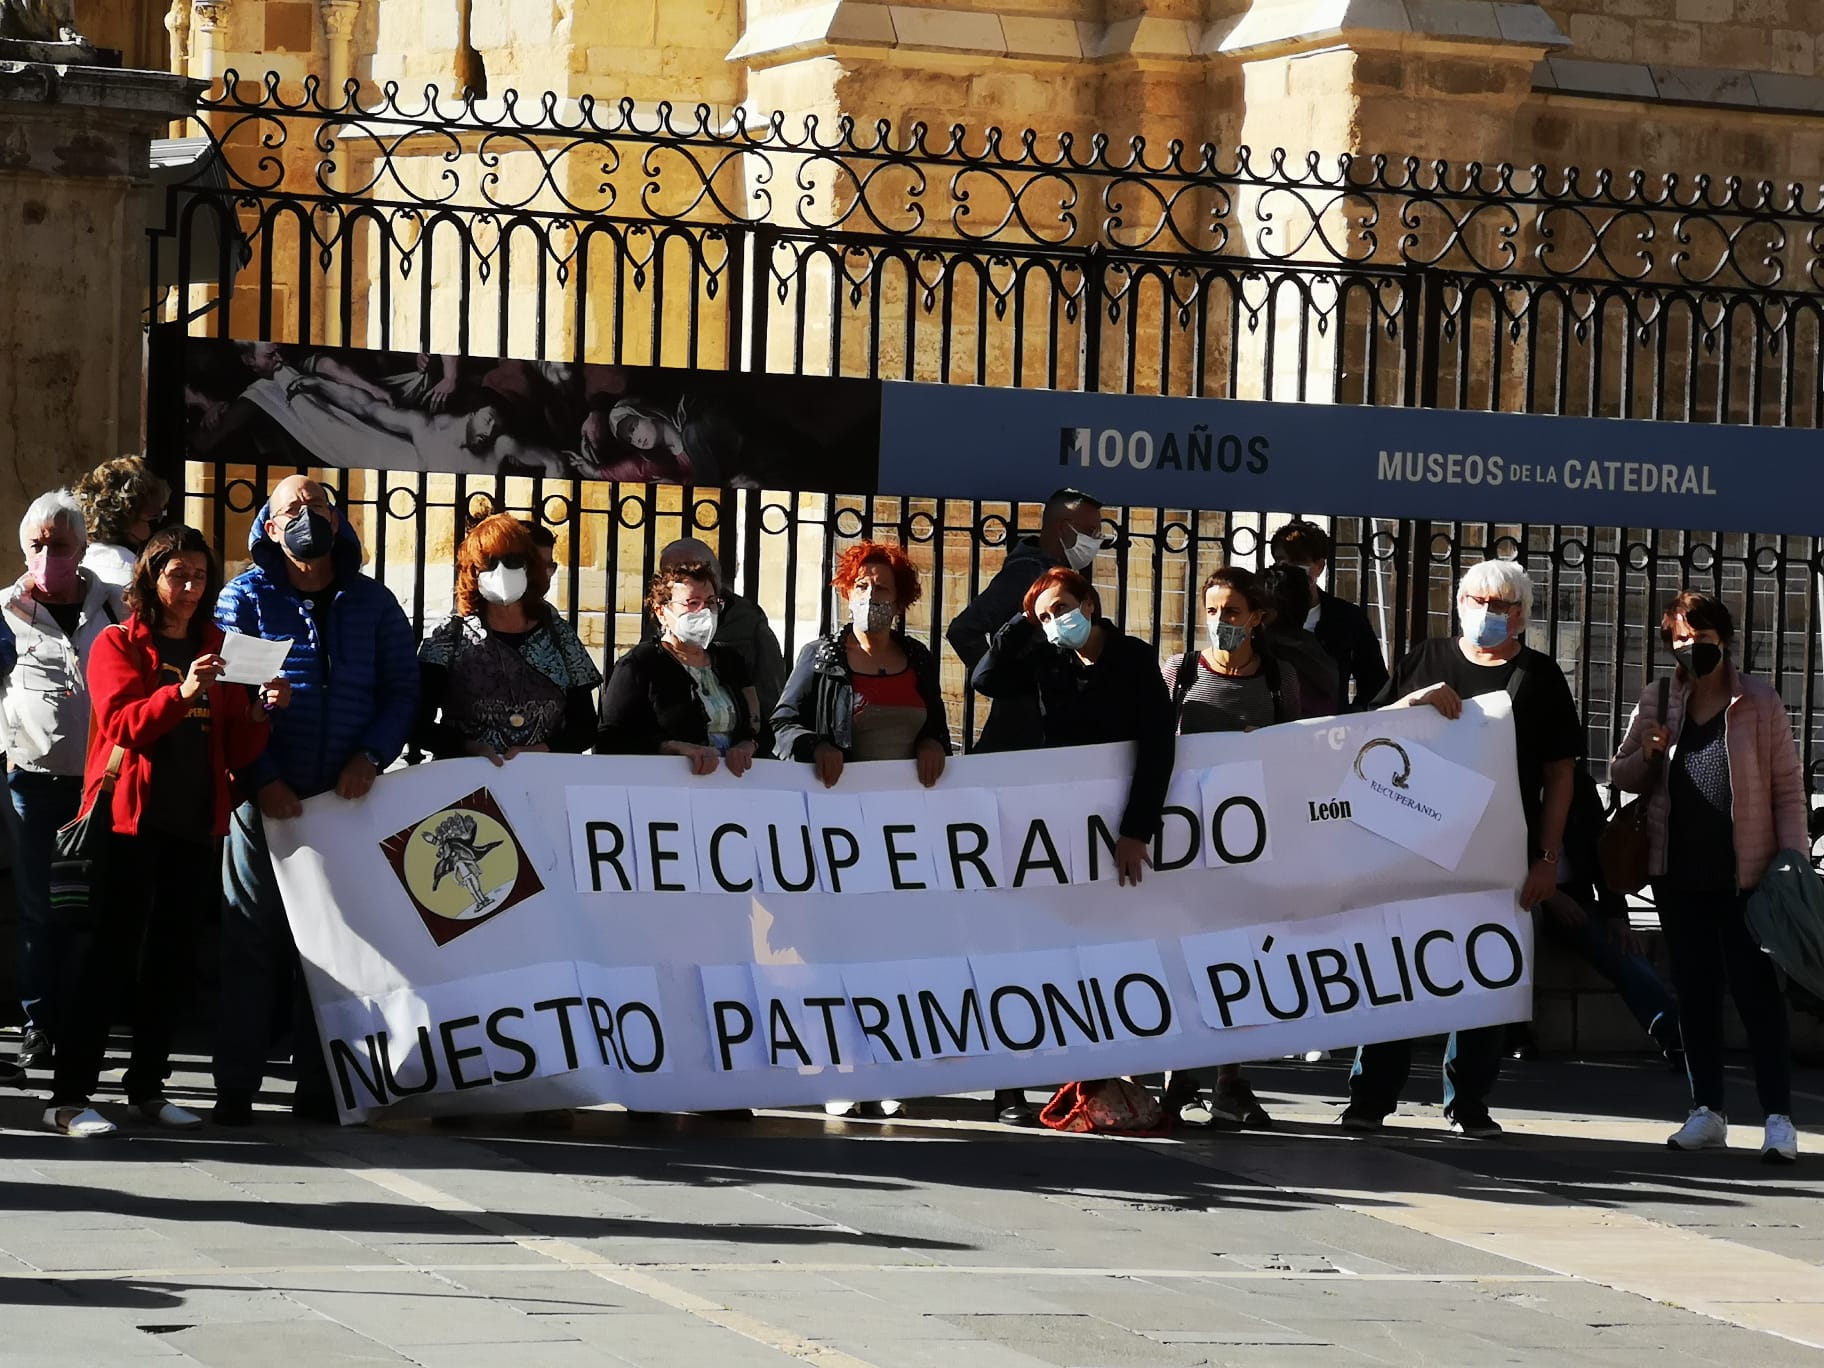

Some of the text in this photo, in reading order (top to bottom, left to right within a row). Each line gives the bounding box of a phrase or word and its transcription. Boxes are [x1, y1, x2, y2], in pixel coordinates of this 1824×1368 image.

[1378, 450, 1717, 495] MUSEOS DE LA CATEDRAL
[1308, 798, 1352, 822] León
[1369, 779, 1443, 823] RECUPERANDO
[329, 922, 1524, 1110] NUESTRO PATRIMONIO PÚBLICO
